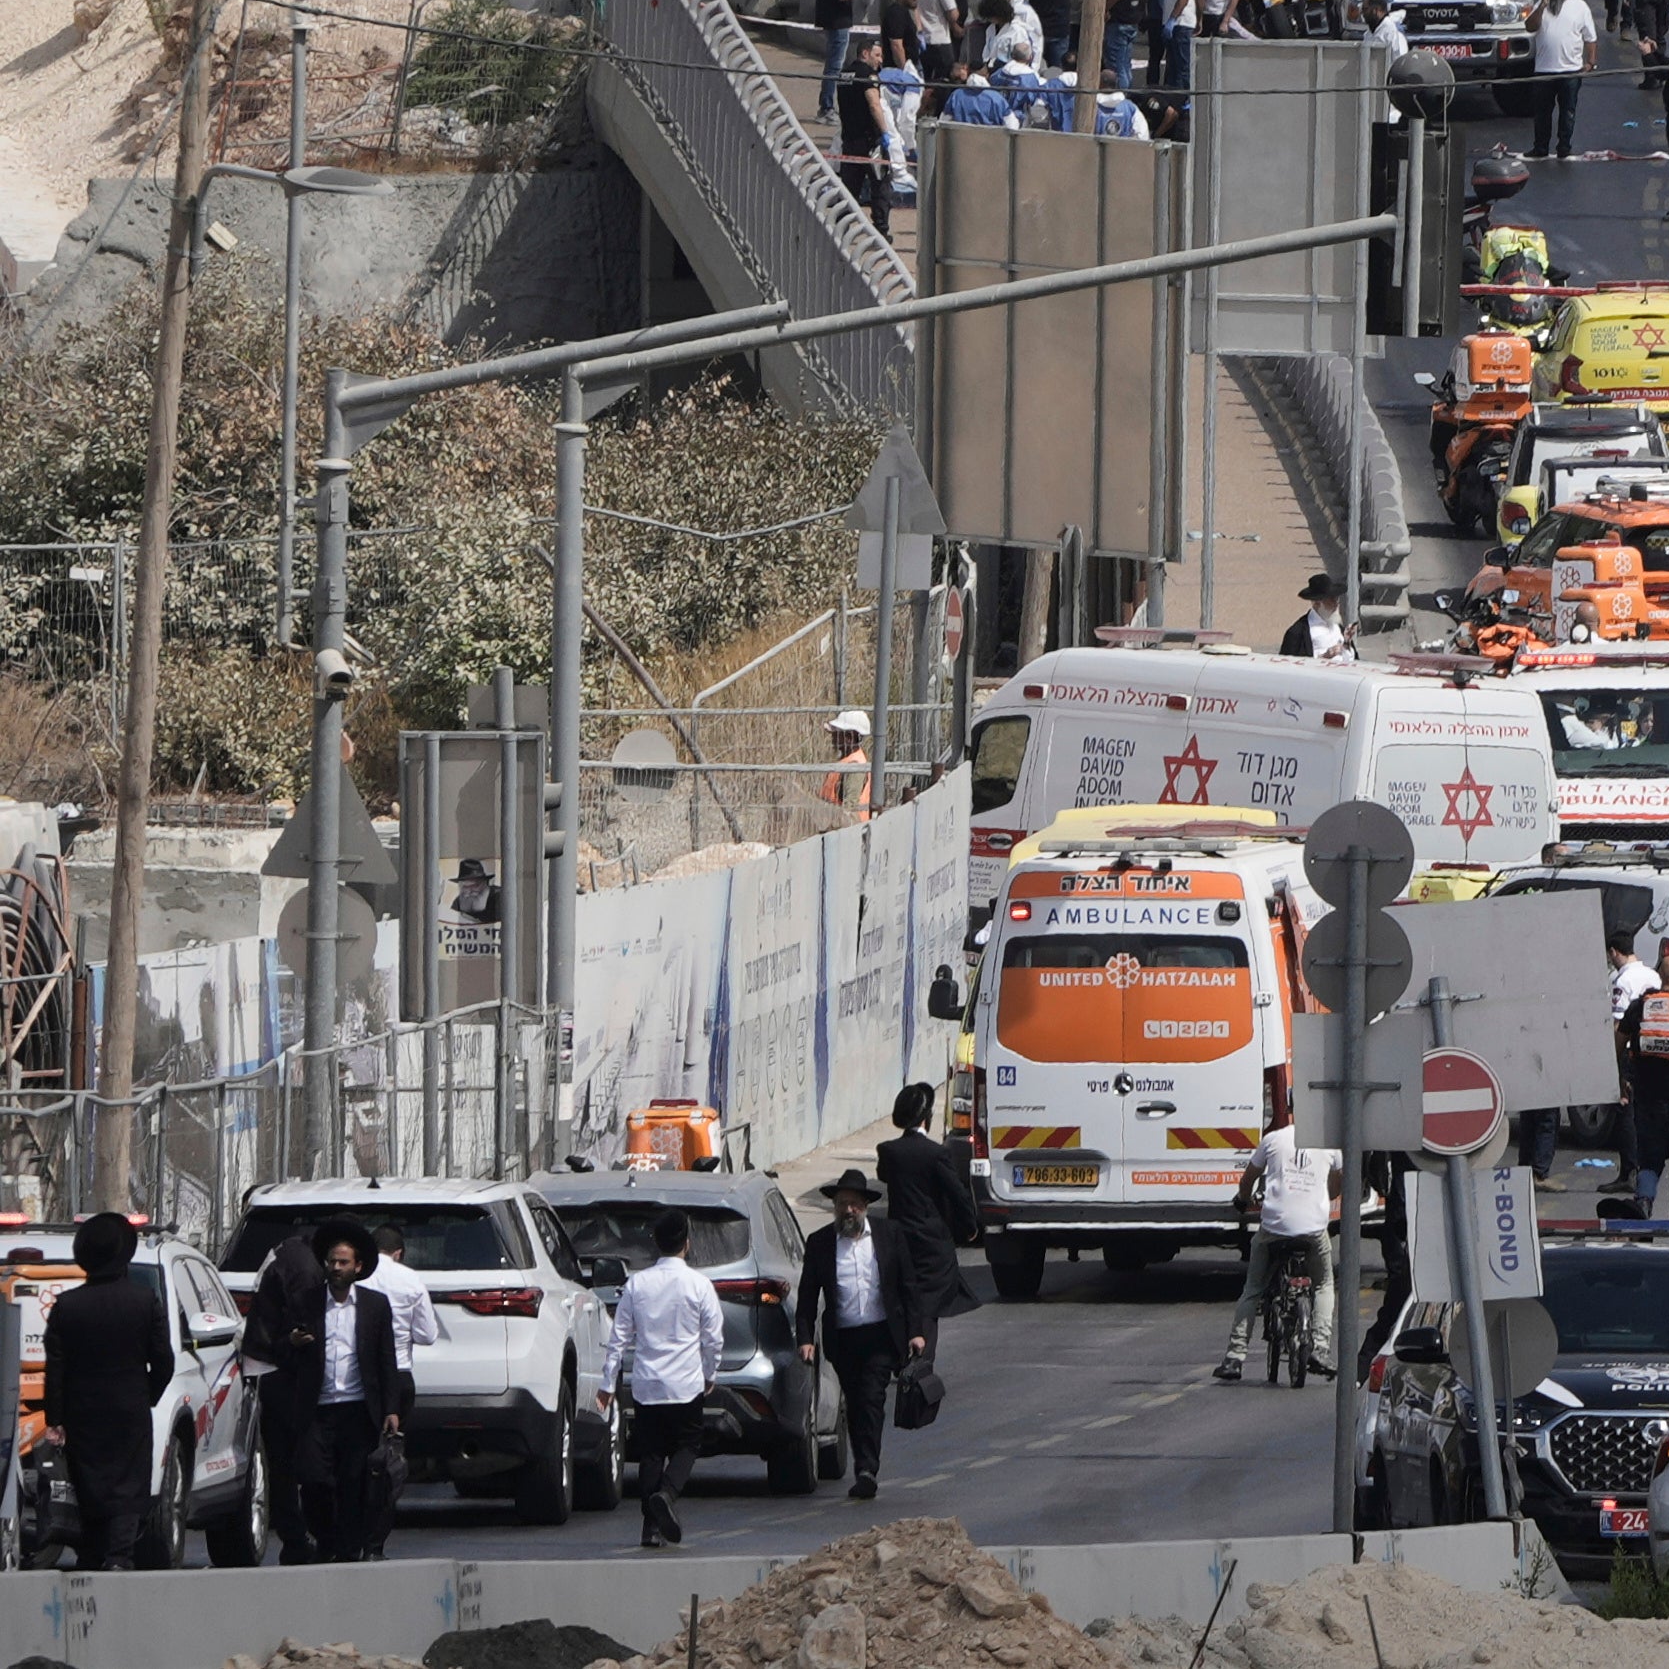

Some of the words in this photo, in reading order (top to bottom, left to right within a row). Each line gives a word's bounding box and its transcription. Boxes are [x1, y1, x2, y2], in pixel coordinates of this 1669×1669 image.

[1422, 8, 1459, 19] TOYOTA
[1195, 697, 1239, 715] ארגון
[1082, 736, 1136, 758] MAGEN
[1080, 757, 1126, 777] DAVID
[1237, 751, 1265, 769] דוד
[1269, 757, 1298, 781] מגן
[1076, 779, 1122, 797] ADOM
[1251, 781, 1296, 806] אדום
[1388, 782, 1427, 793] MAGEN
[1388, 792, 1421, 803] DAVID
[1060, 874, 1123, 893] הצלה
[1129, 874, 1190, 891] איחוד
[1047, 908, 1210, 926] AMBULANCE
[1039, 970, 1104, 987] UNITED
[1141, 969, 1237, 988] HATZALAH
[1165, 1024, 1225, 1036] 1221
[998, 1068, 1015, 1084] 84
